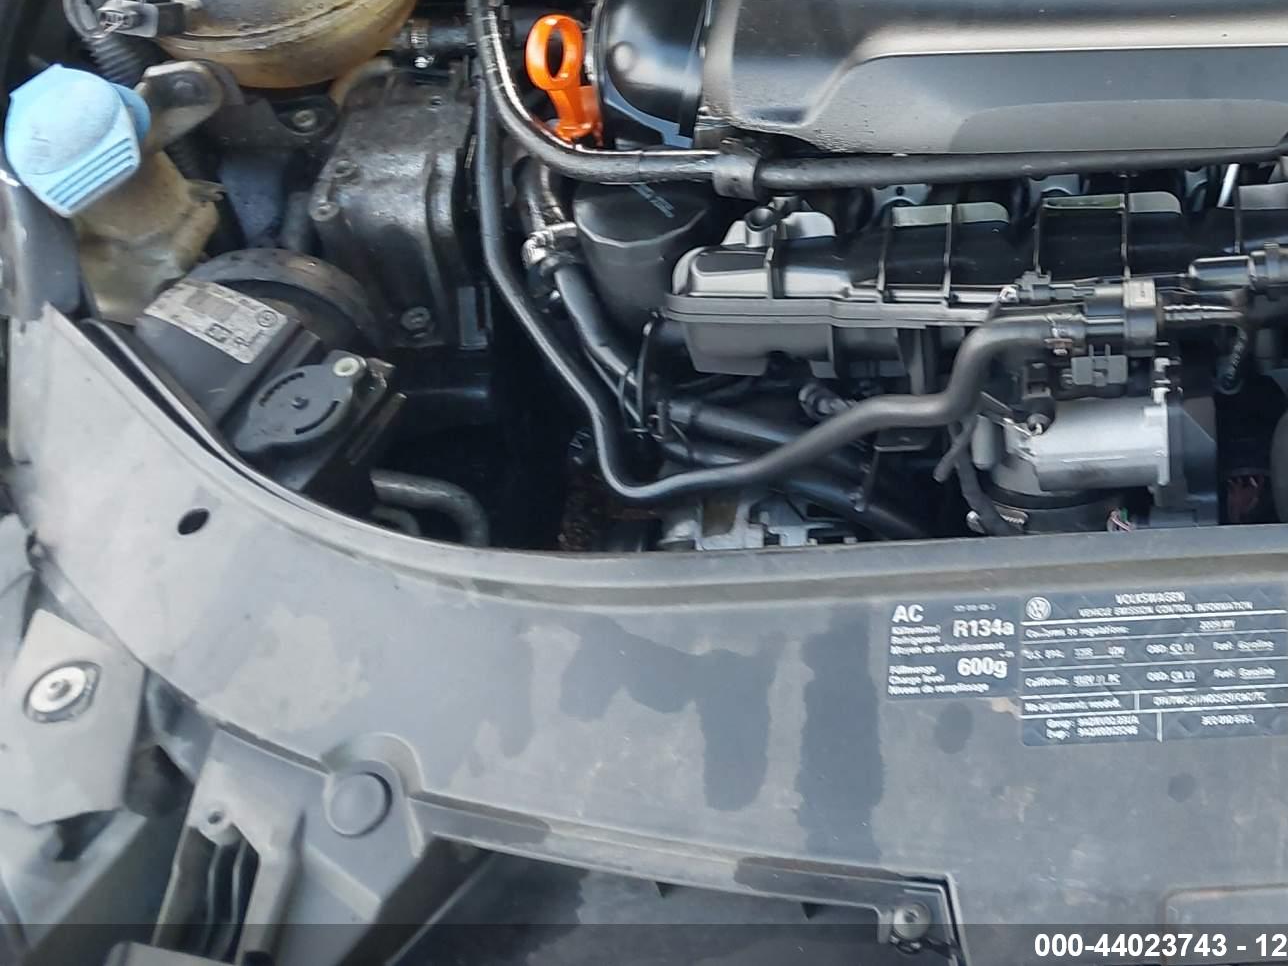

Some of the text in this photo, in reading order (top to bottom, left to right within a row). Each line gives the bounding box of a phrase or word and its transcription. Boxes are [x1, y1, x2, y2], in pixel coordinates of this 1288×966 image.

[891, 603, 925, 623] AC
[952, 619, 1015, 638] R134a
[957, 656, 1008, 679] 600g
